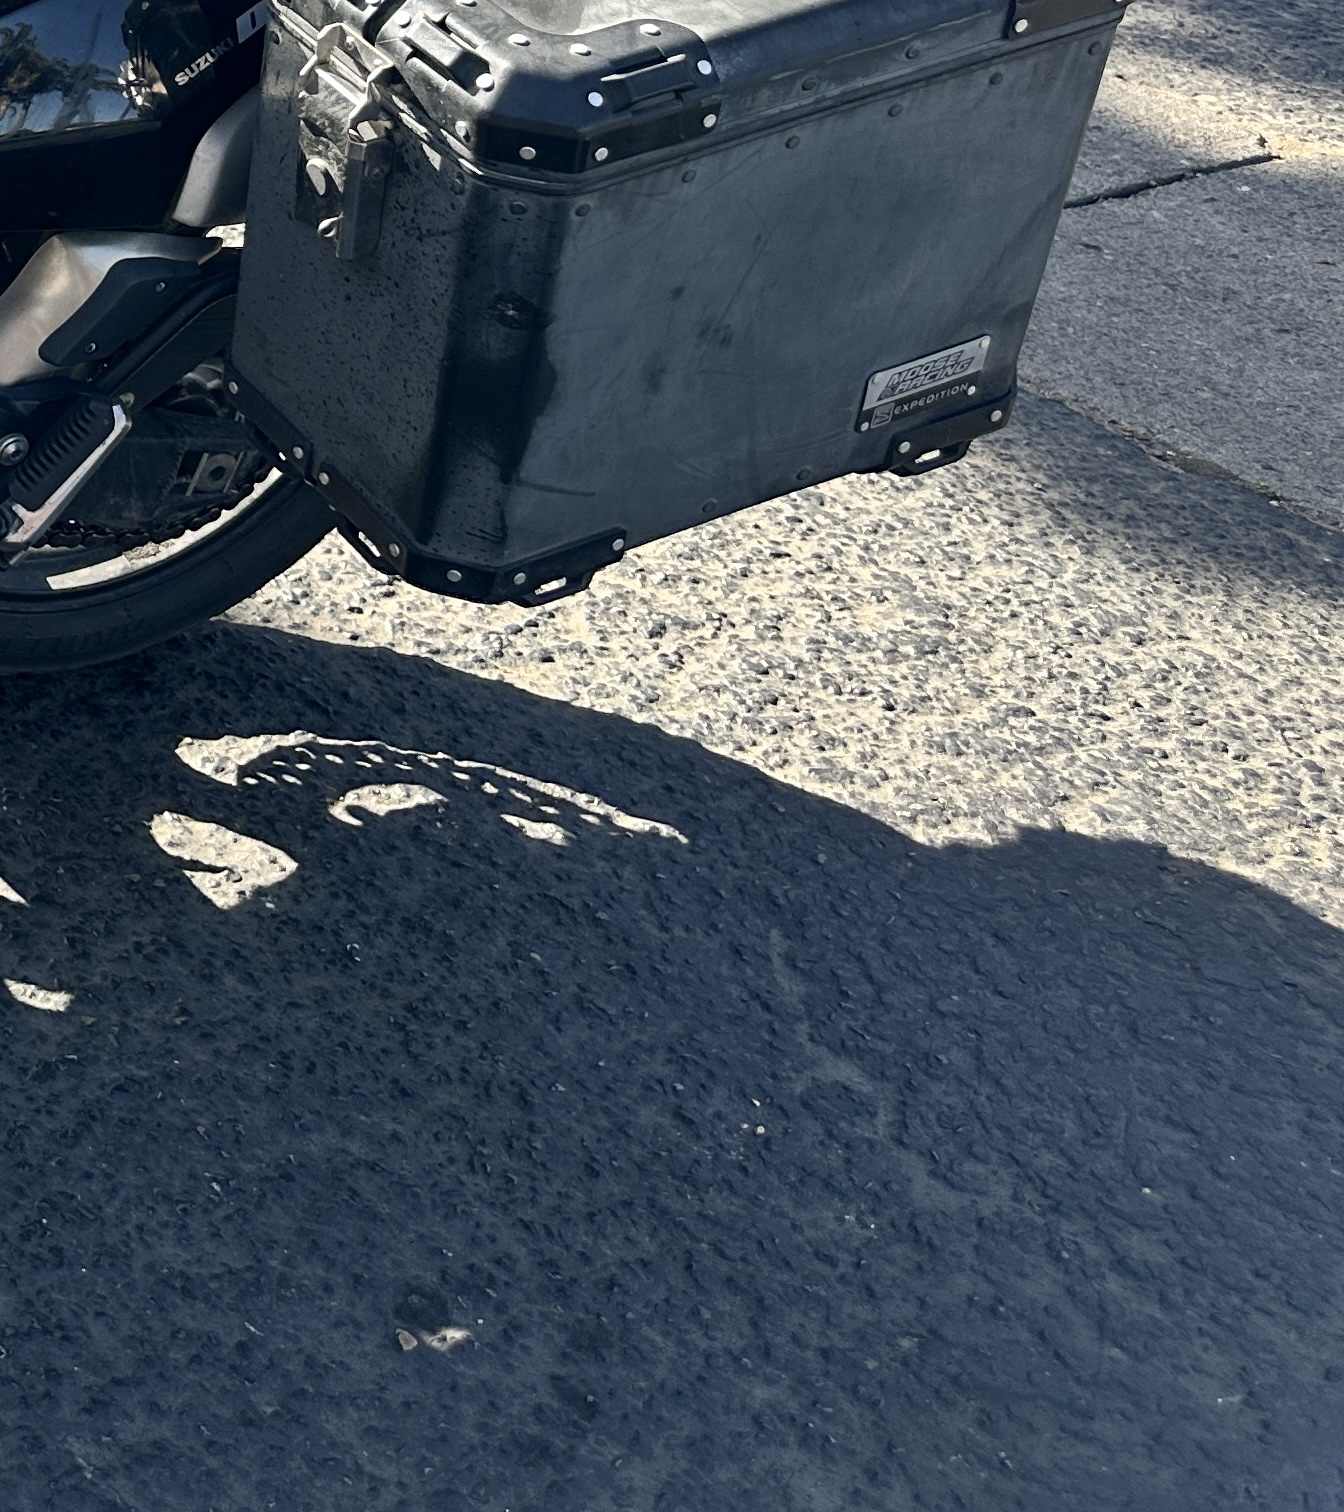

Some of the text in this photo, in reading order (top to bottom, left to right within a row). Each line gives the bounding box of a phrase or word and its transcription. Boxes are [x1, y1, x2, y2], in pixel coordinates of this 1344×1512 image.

[174, 37, 235, 86] SUZUKI
[888, 350, 964, 386] MOOSE
[893, 356, 975, 395] RACING
[894, 382, 969, 415] EXPEDITION
